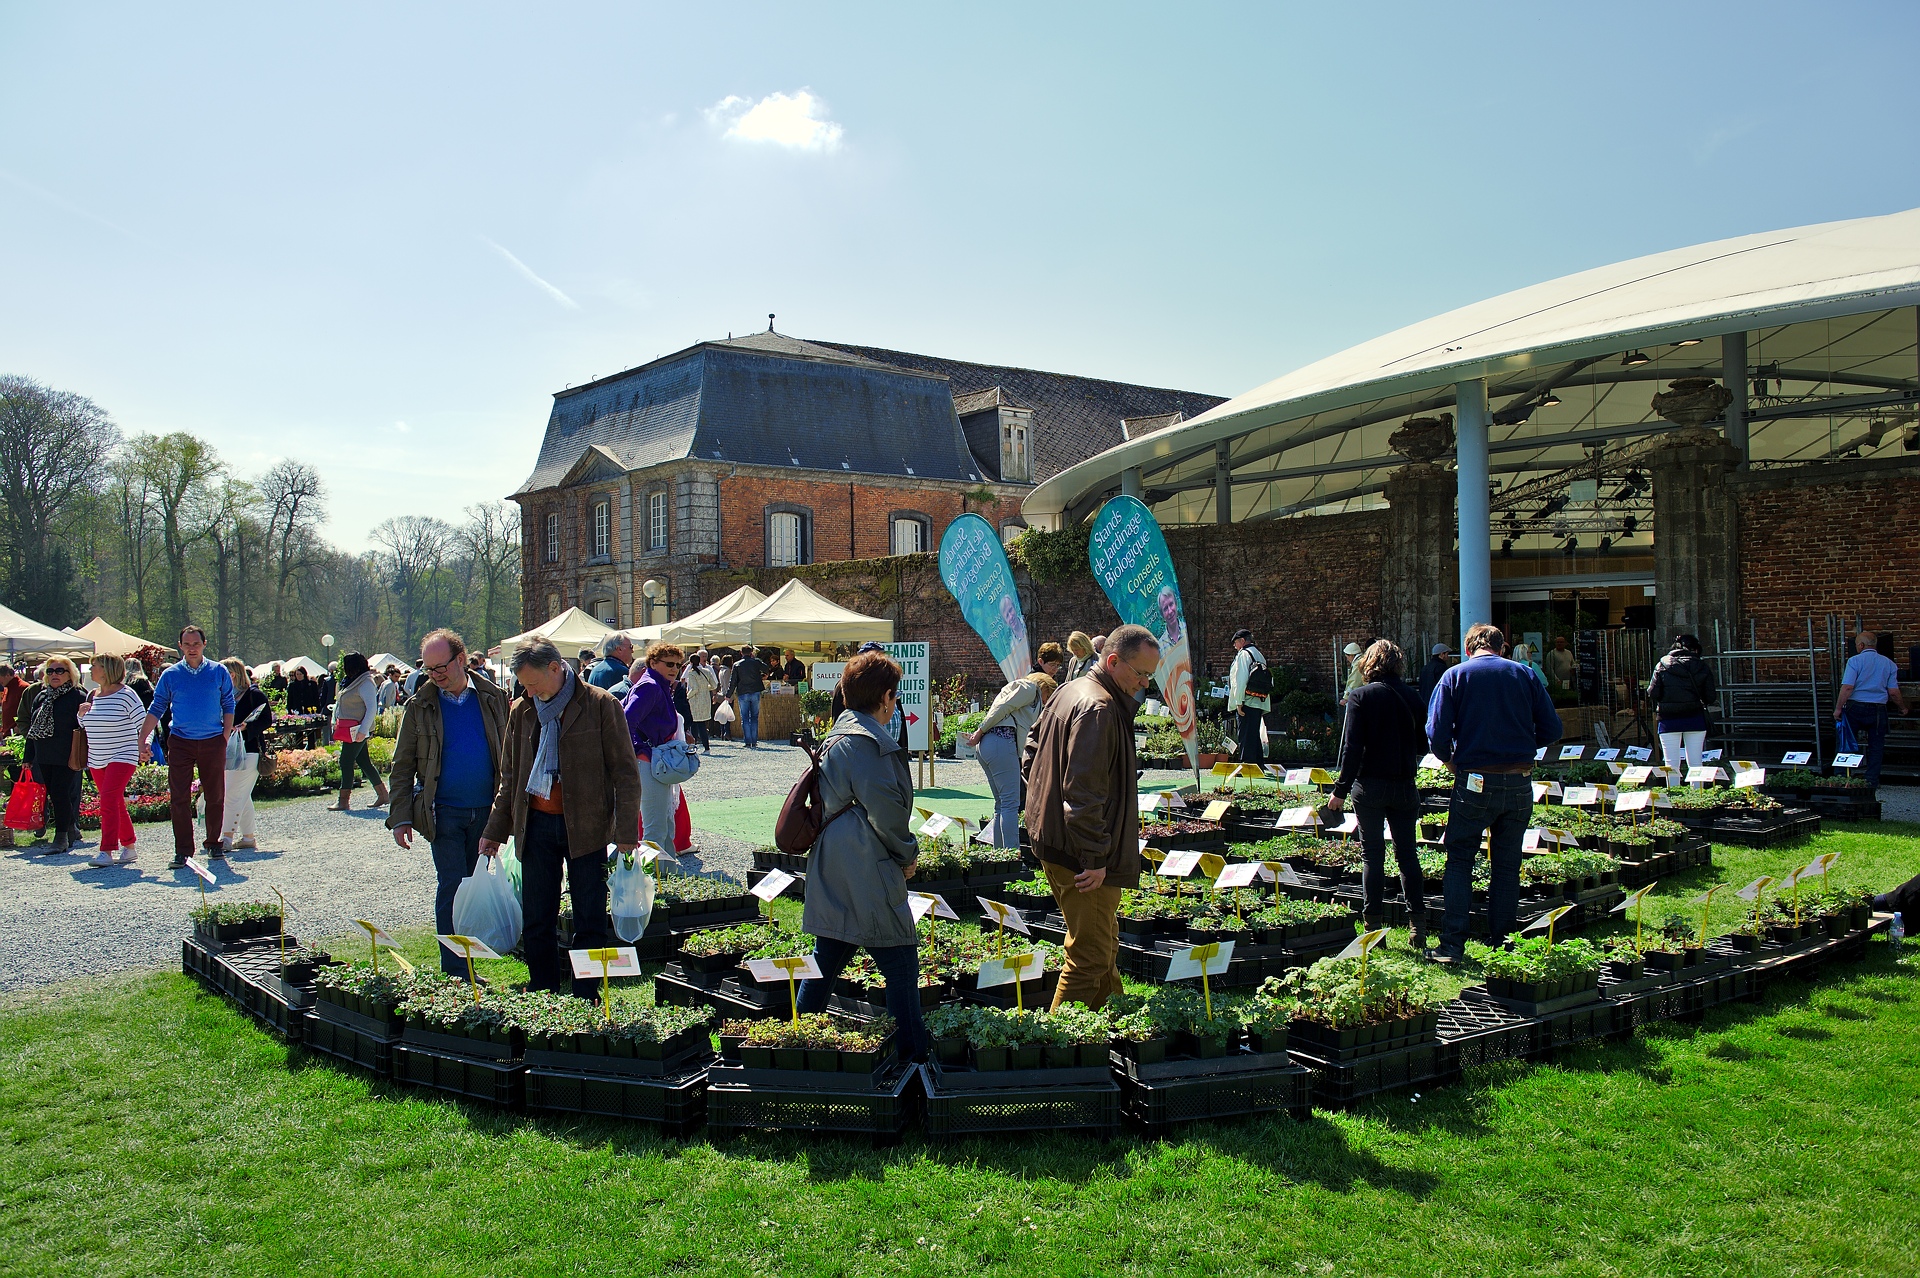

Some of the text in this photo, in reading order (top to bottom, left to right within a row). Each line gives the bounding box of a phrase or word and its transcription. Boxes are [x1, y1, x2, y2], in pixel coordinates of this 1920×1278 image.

[1094, 510, 1122, 549] Stands
[1095, 512, 1142, 576] de Jardinage
[1104, 530, 1150, 588] Biologique
[1127, 553, 1160, 594] Conseils
[1140, 570, 1164, 598] Vente
[882, 644, 925, 658] TANDS
[816, 672, 836, 680] SALLE
[898, 661, 919, 675] NTE
[900, 692, 921, 705] UREL
